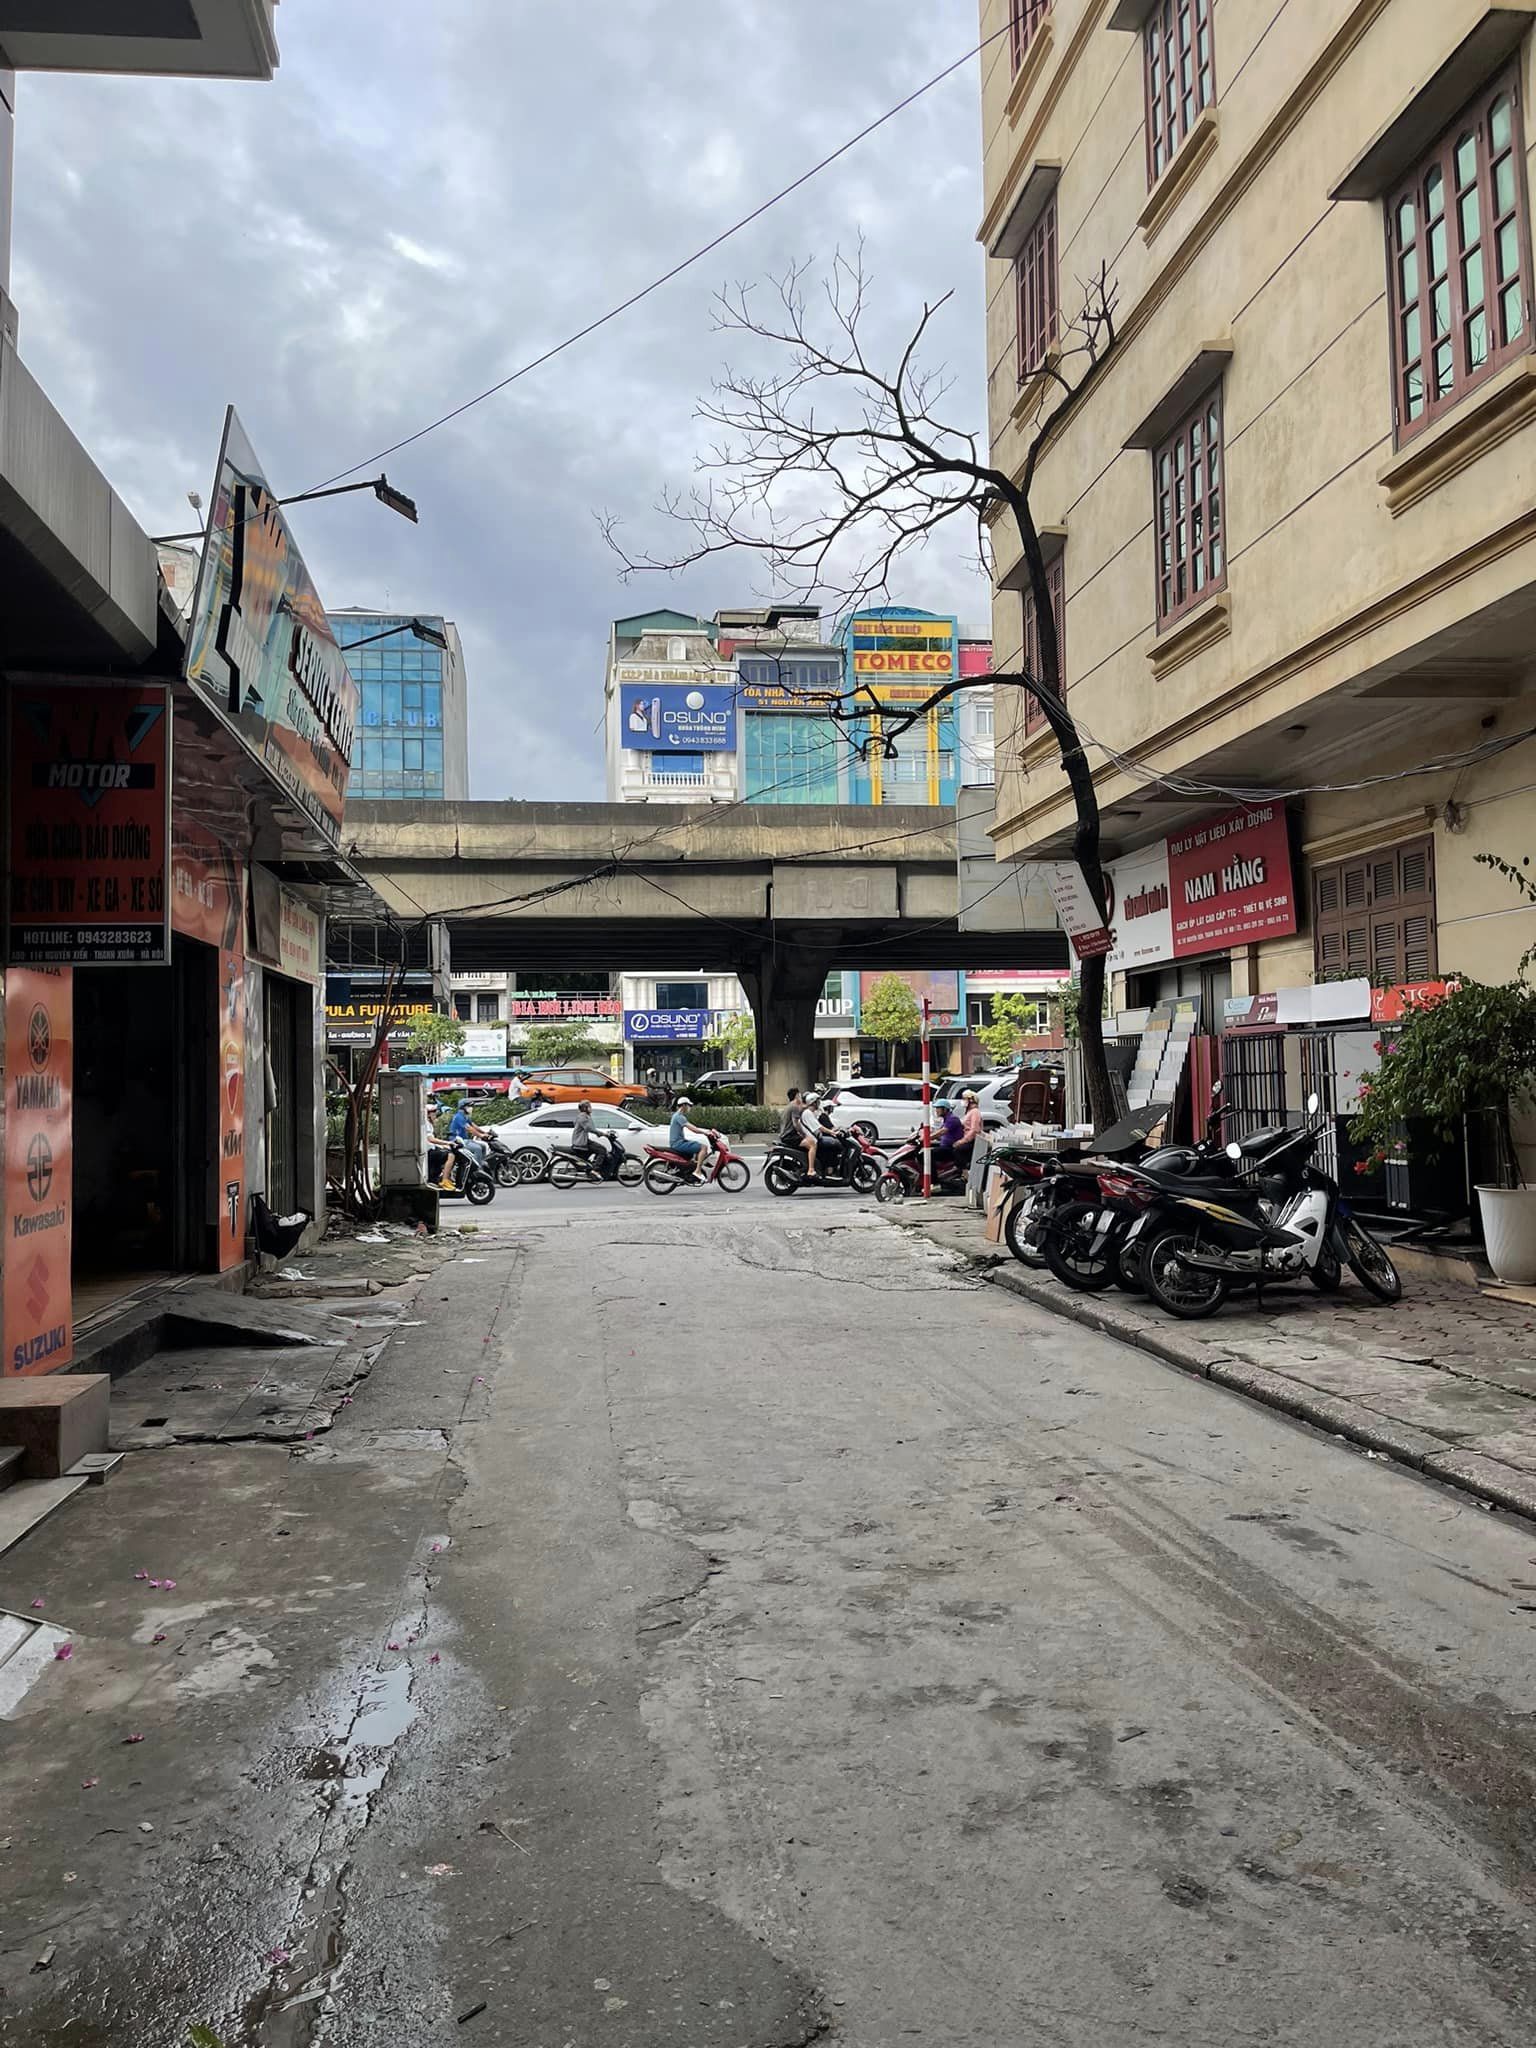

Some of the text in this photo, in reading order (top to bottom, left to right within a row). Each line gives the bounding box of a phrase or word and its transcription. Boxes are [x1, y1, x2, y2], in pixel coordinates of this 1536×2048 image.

[294, 624, 331, 723] SERVICE
[852, 653, 951, 671] TOMECO
[663, 711, 727, 724] OSUNO
[48, 763, 132, 788] MOTOR
[86, 814, 108, 859] BẢO
[112, 815, 151, 860] DƯỠNG
[1209, 824, 1226, 842] LIỆU
[1228, 815, 1245, 835] XÂY
[1247, 807, 1273, 828] DỰNG
[87, 876, 100, 912] XE
[104, 876, 120, 912] GA
[130, 876, 145, 912] XE
[148, 863, 163, 912] SỐ
[1184, 873, 1216, 904] NAM
[1221, 853, 1265, 893] HẰNG
[23, 930, 152, 946] HOTLINE: 0943283623
[650, 1014, 698, 1024] OSUNO
[15, 1075, 61, 1111] YAMAHA
[223, 1129, 242, 1160] KTM
[13, 1202, 66, 1238] Kawasaki
[13, 1324, 67, 1371] SUZUKI
